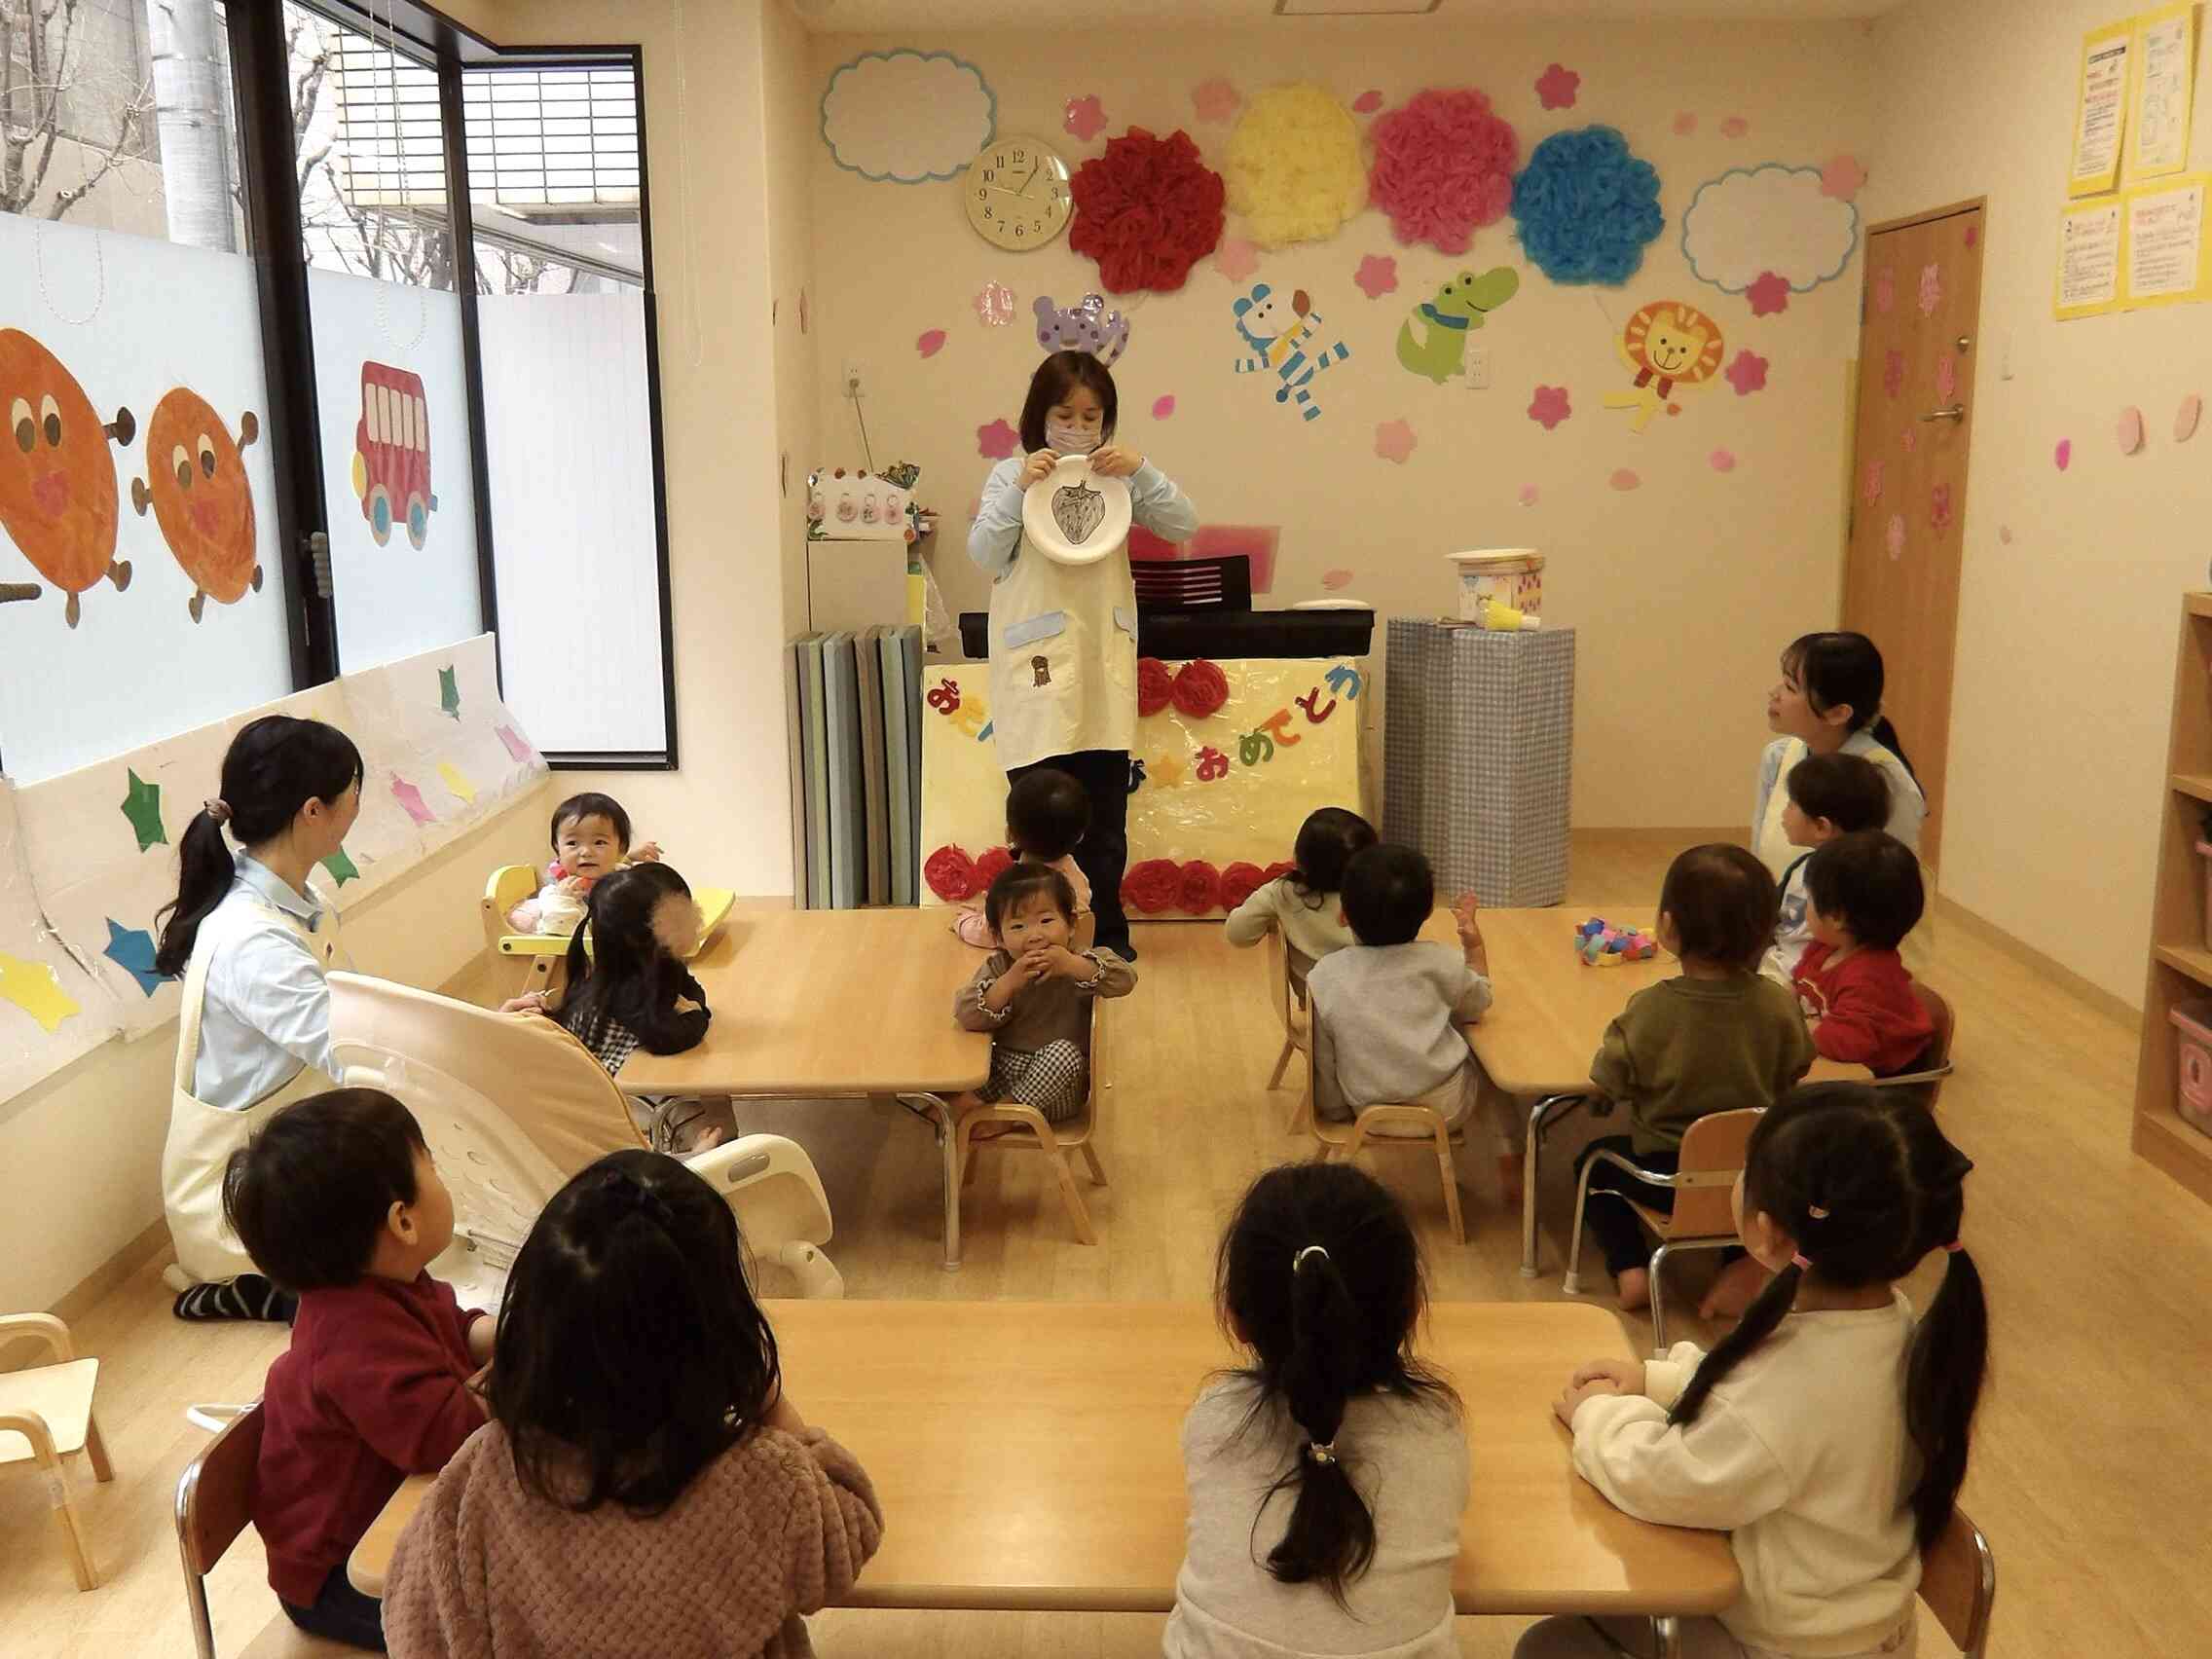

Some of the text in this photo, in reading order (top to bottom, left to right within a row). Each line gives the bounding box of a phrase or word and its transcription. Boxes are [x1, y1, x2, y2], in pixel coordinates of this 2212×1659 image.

[996, 156, 1005, 168] 11
[1013, 150, 1025, 164] 12
[982, 169, 995, 183] 10
[1046, 169, 1053, 181] 2
[978, 188, 987, 201] 9
[1051, 187, 1059, 200] 3
[984, 206, 993, 219] 8
[997, 220, 1006, 233] 7
[1015, 224, 1024, 237] 6
[1034, 220, 1041, 233] 5
